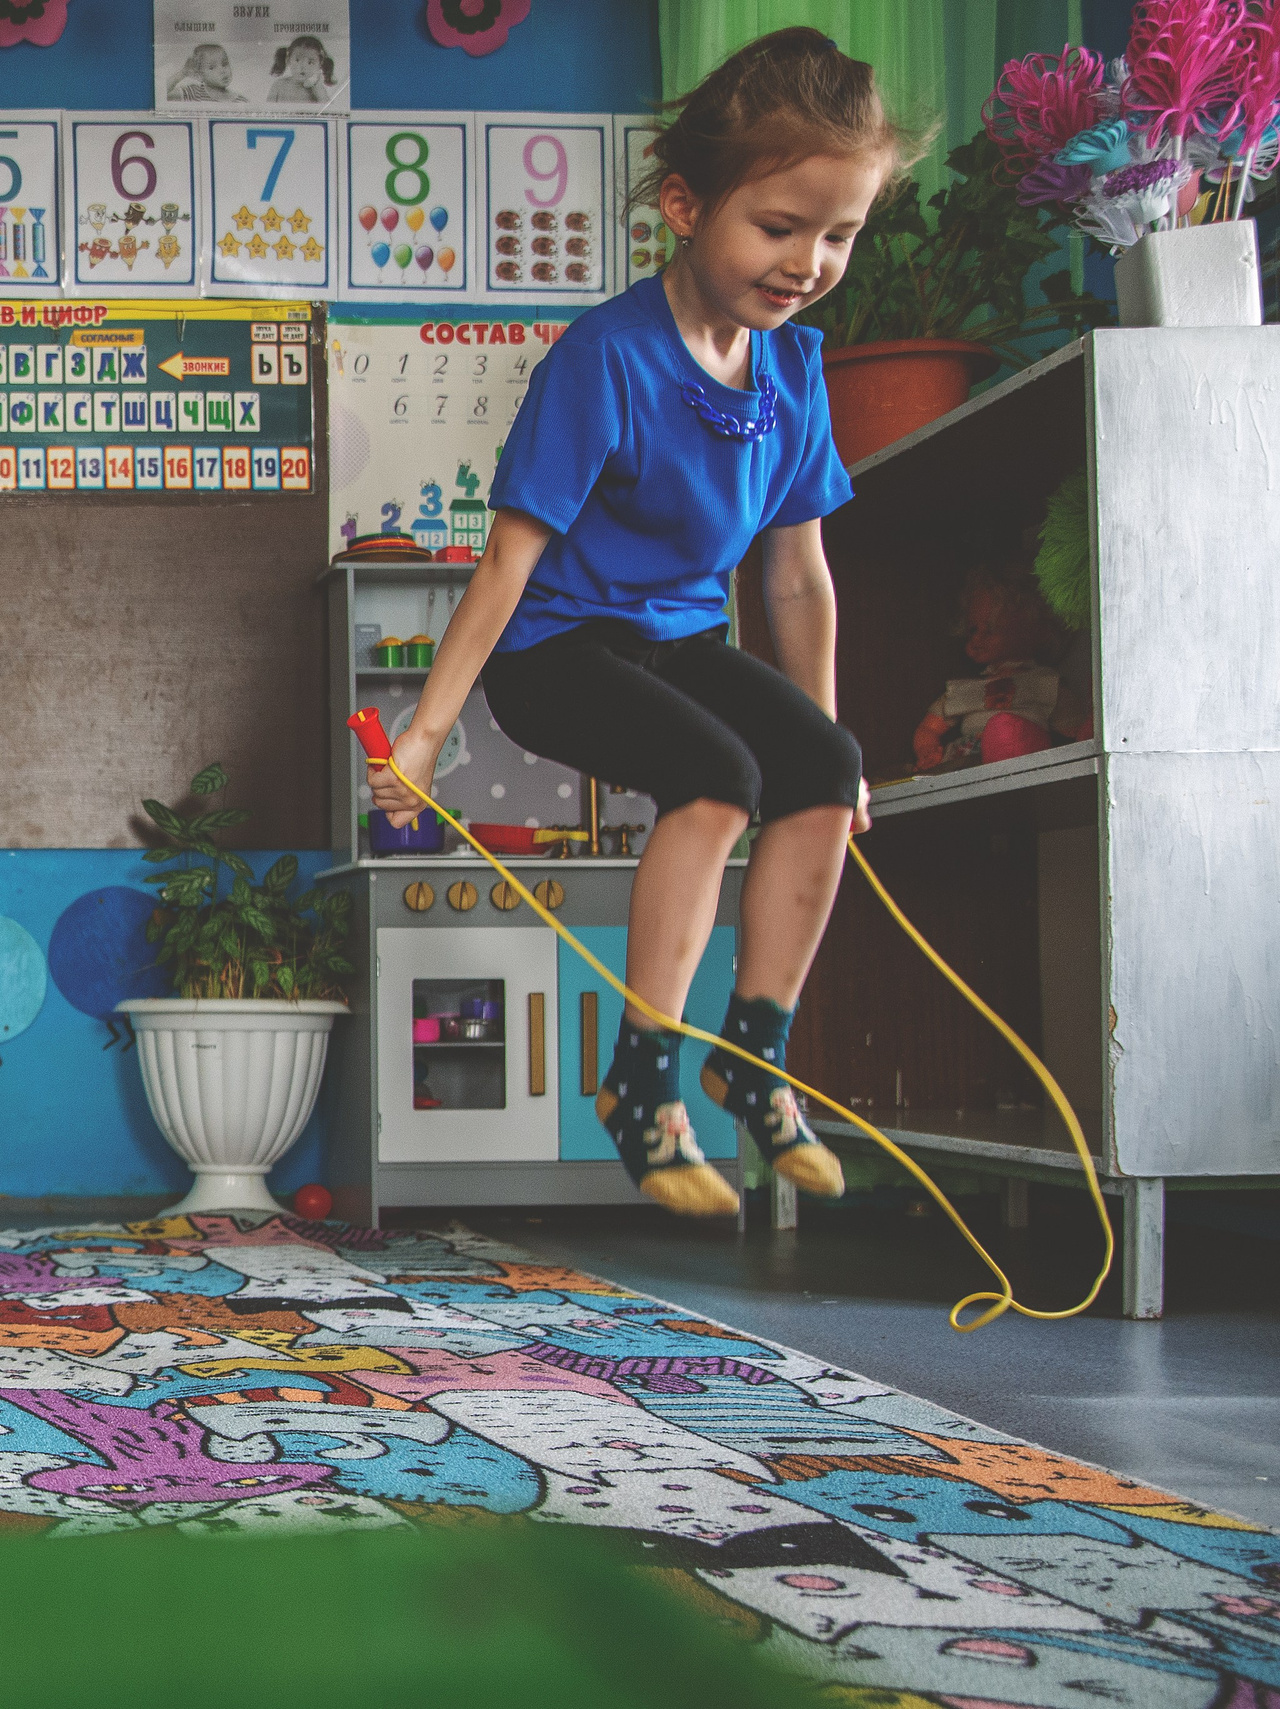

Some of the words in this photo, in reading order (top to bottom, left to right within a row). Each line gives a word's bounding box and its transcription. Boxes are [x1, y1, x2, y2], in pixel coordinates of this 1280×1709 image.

[233, 6, 269, 18] ЗВУКИ
[111, 131, 157, 201] 6
[247, 129, 295, 201] 7
[385, 132, 430, 206] 8
[523, 135, 568, 208] 9
[21, 307, 36, 324] И
[43, 306, 107, 327] ЦИФР
[81, 334, 134, 342] СОГЛАСНЫЕ
[420, 324, 525, 344] СОСТАВ
[15, 353, 30, 376] В
[46, 353, 58, 377] Г
[72, 353, 85, 376] З
[97, 353, 116, 380] Д
[124, 353, 144, 377] Ж
[183, 362, 226, 372] ЗВОНКИЕ
[354, 354, 369, 374] 0
[399, 354, 409, 374] 1
[434, 355, 448, 375] 2
[474, 356, 488, 376] 3
[514, 356, 527, 376] 4
[12, 401, 32, 425] Ф
[44, 402, 59, 425] К
[75, 402, 87, 425] С
[101, 402, 116, 425] Т
[125, 402, 145, 425] Ш
[156, 402, 172, 429] Ц
[184, 401, 198, 425] Ч
[209, 402, 230, 429] Щ
[240, 402, 255, 425] Х
[394, 396, 408, 416] 6
[436, 396, 448, 416] 7
[474, 396, 488, 416] 8
[22, 459, 40, 478] 11
[51, 459, 72, 478] 12
[79, 459, 100, 478] 13
[109, 459, 129, 478] 14
[138, 458, 158, 478] 15
[168, 458, 187, 478] 16
[197, 458, 217, 478] 17
[226, 458, 245, 478] 18
[255, 458, 276, 478] 19
[283, 459, 305, 478] 20
[419, 485, 443, 517] 3
[381, 503, 401, 533] 2
